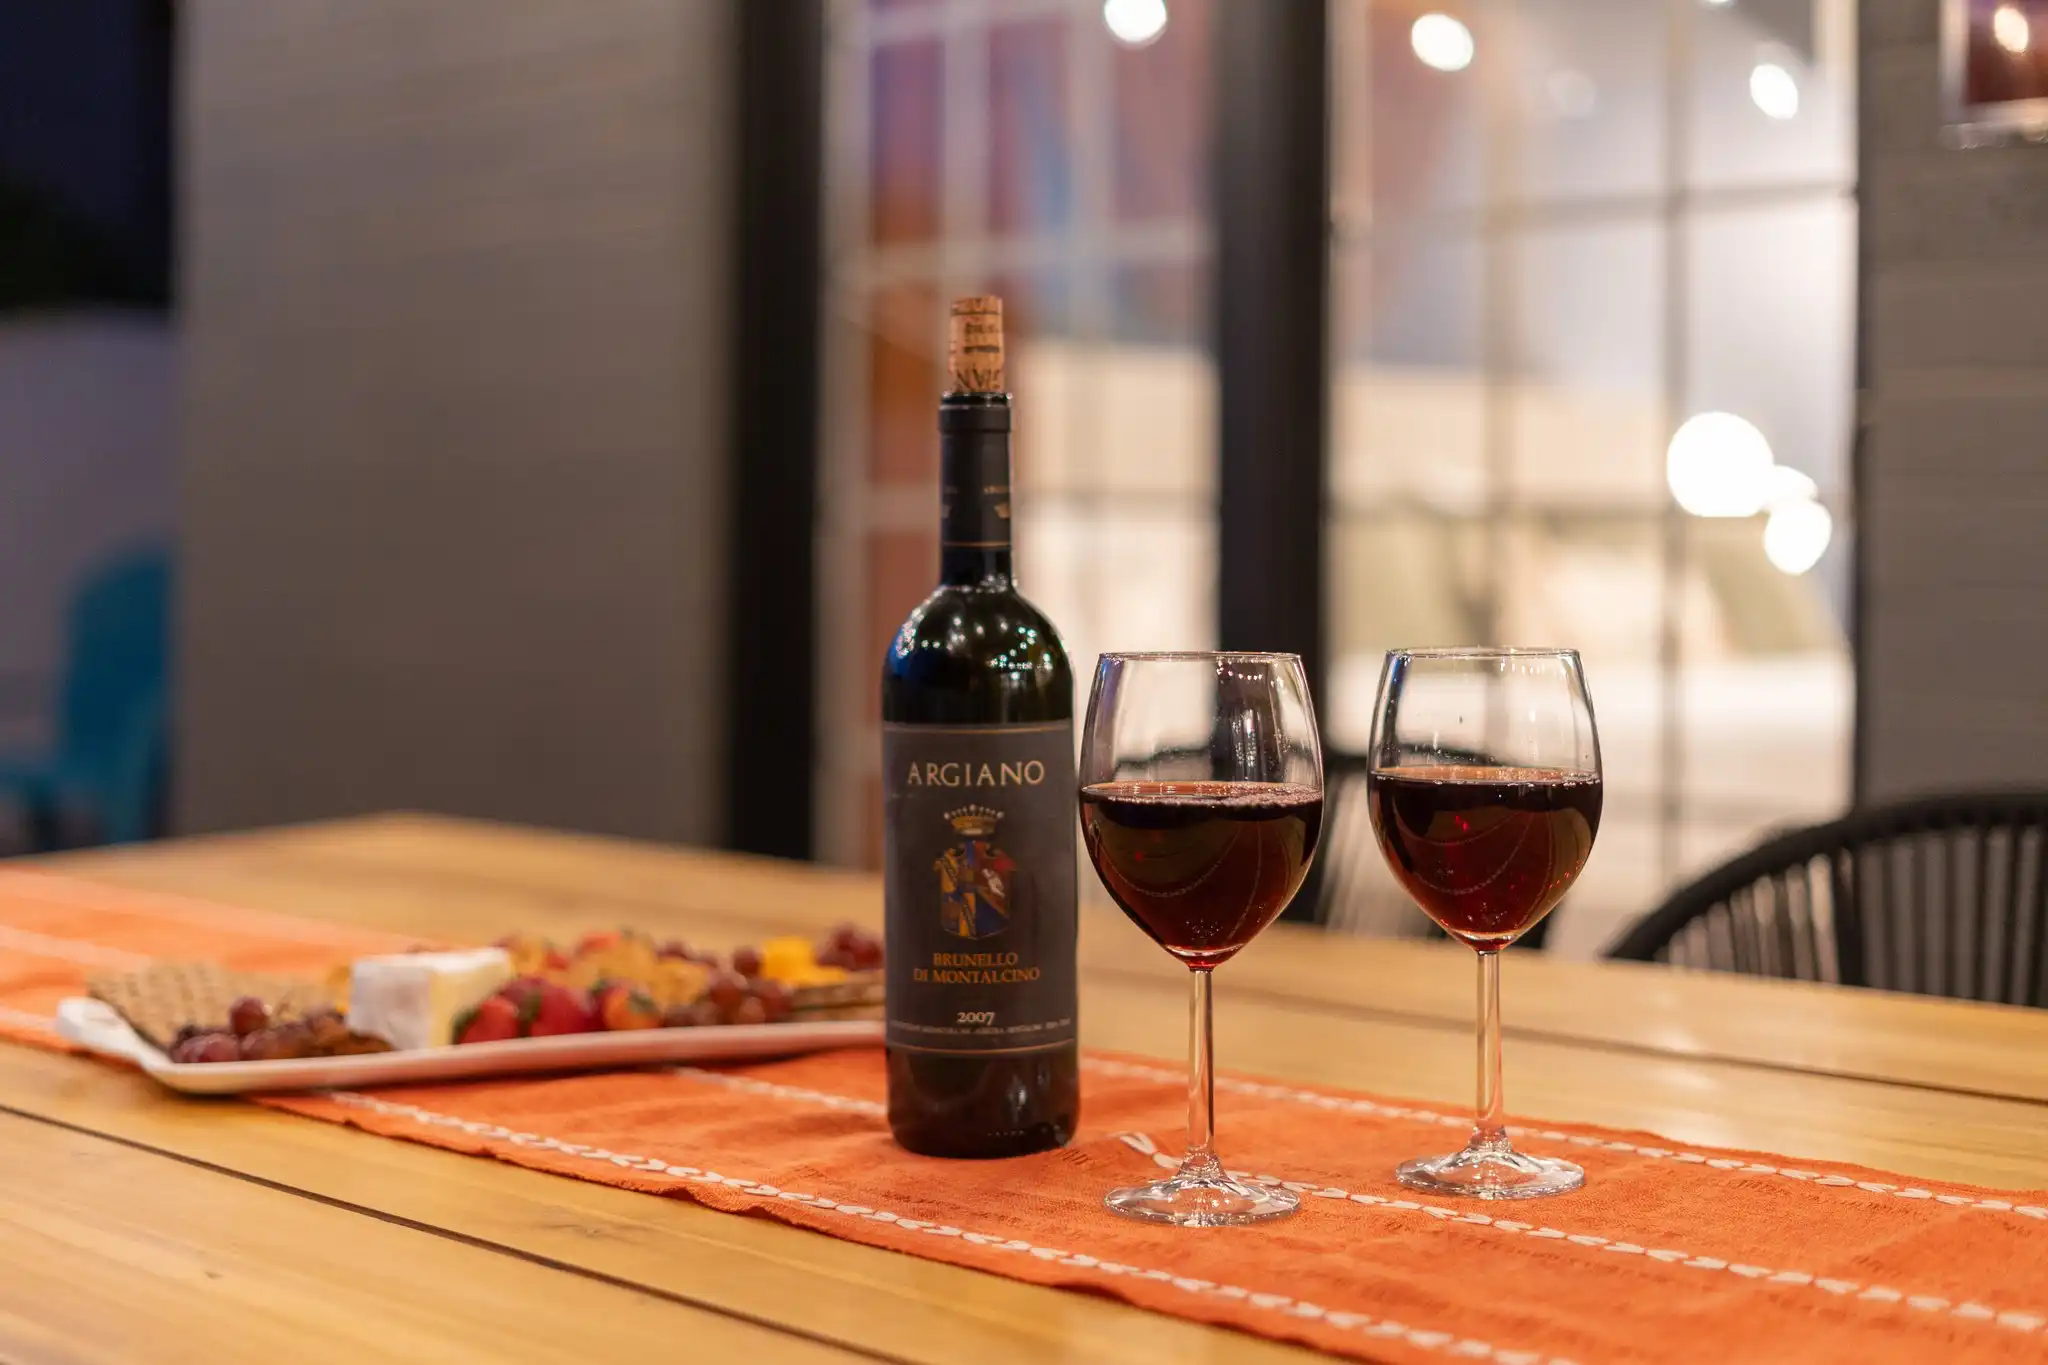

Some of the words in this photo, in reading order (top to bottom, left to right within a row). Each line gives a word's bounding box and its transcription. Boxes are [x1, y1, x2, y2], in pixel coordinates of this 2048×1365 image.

[907, 760, 1046, 787] ARGIANO
[933, 952, 1018, 966] BRUNELLO
[914, 969, 928, 981] DI
[934, 967, 1040, 983] MONTALCINO
[956, 1011, 996, 1026] 2007
